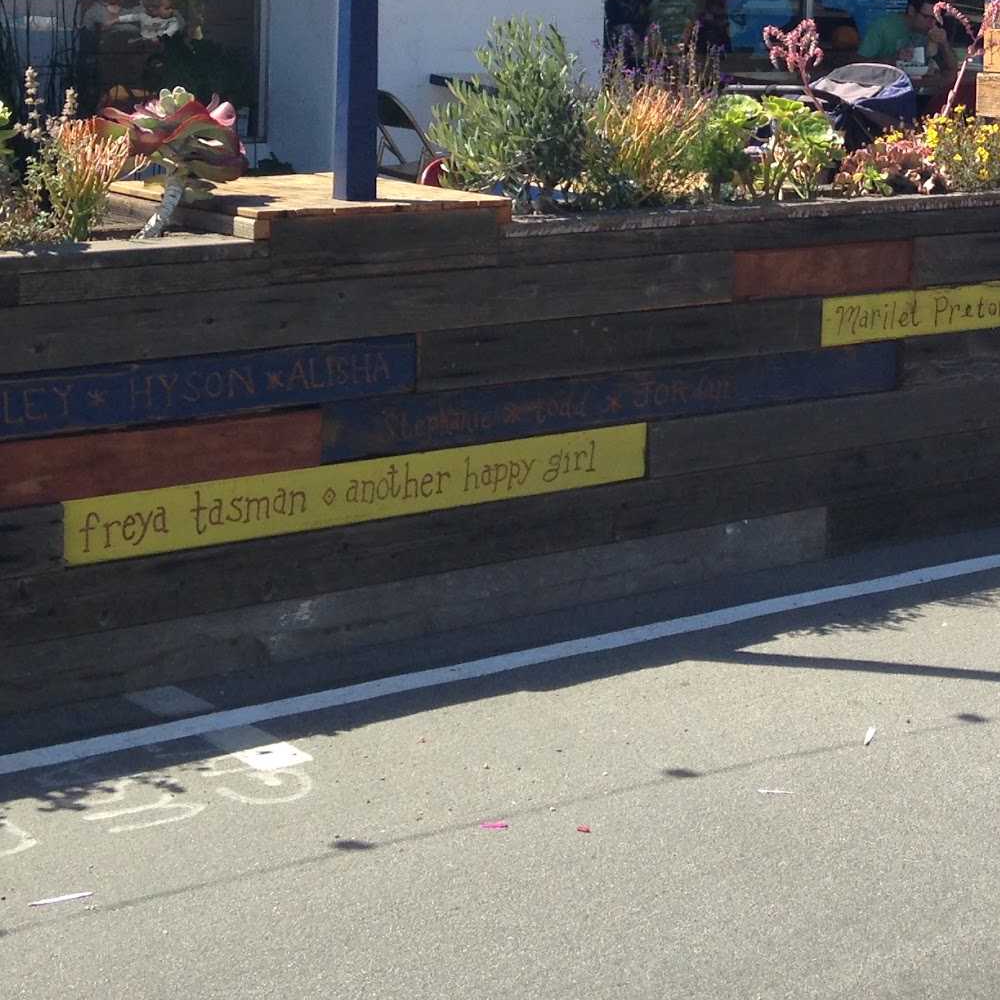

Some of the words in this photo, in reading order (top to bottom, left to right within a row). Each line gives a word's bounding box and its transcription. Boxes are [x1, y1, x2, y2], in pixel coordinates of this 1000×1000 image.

[836, 301, 918, 335] Marilet
[129, 368, 256, 409] HYSON
[286, 352, 392, 391] ALISHA
[79, 505, 169, 554] freya
[190, 491, 307, 535] tasman
[345, 463, 451, 505] another
[463, 456, 536, 492] happy
[541, 439, 597, 483] girl
